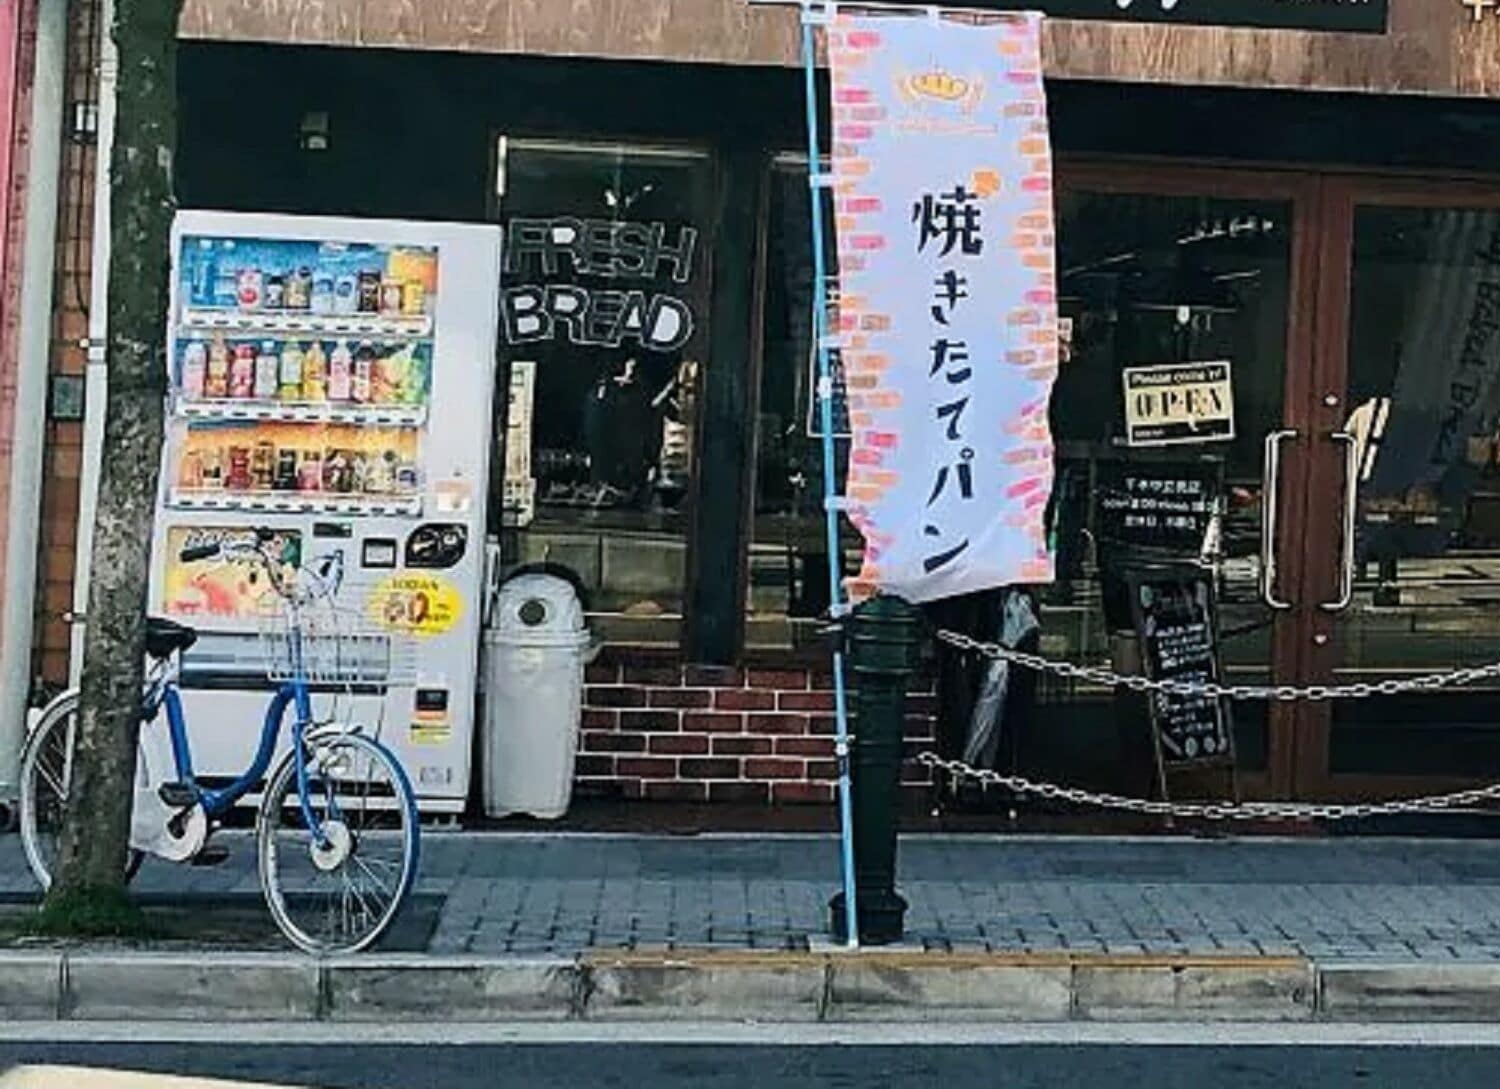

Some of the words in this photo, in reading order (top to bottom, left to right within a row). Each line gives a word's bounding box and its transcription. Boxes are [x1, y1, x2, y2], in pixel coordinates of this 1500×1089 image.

[504, 216, 699, 283] FRESH
[501, 284, 695, 351] BREAD
[911, 185, 984, 574] 焼きたてパン
[1136, 387, 1223, 418] OPEN
